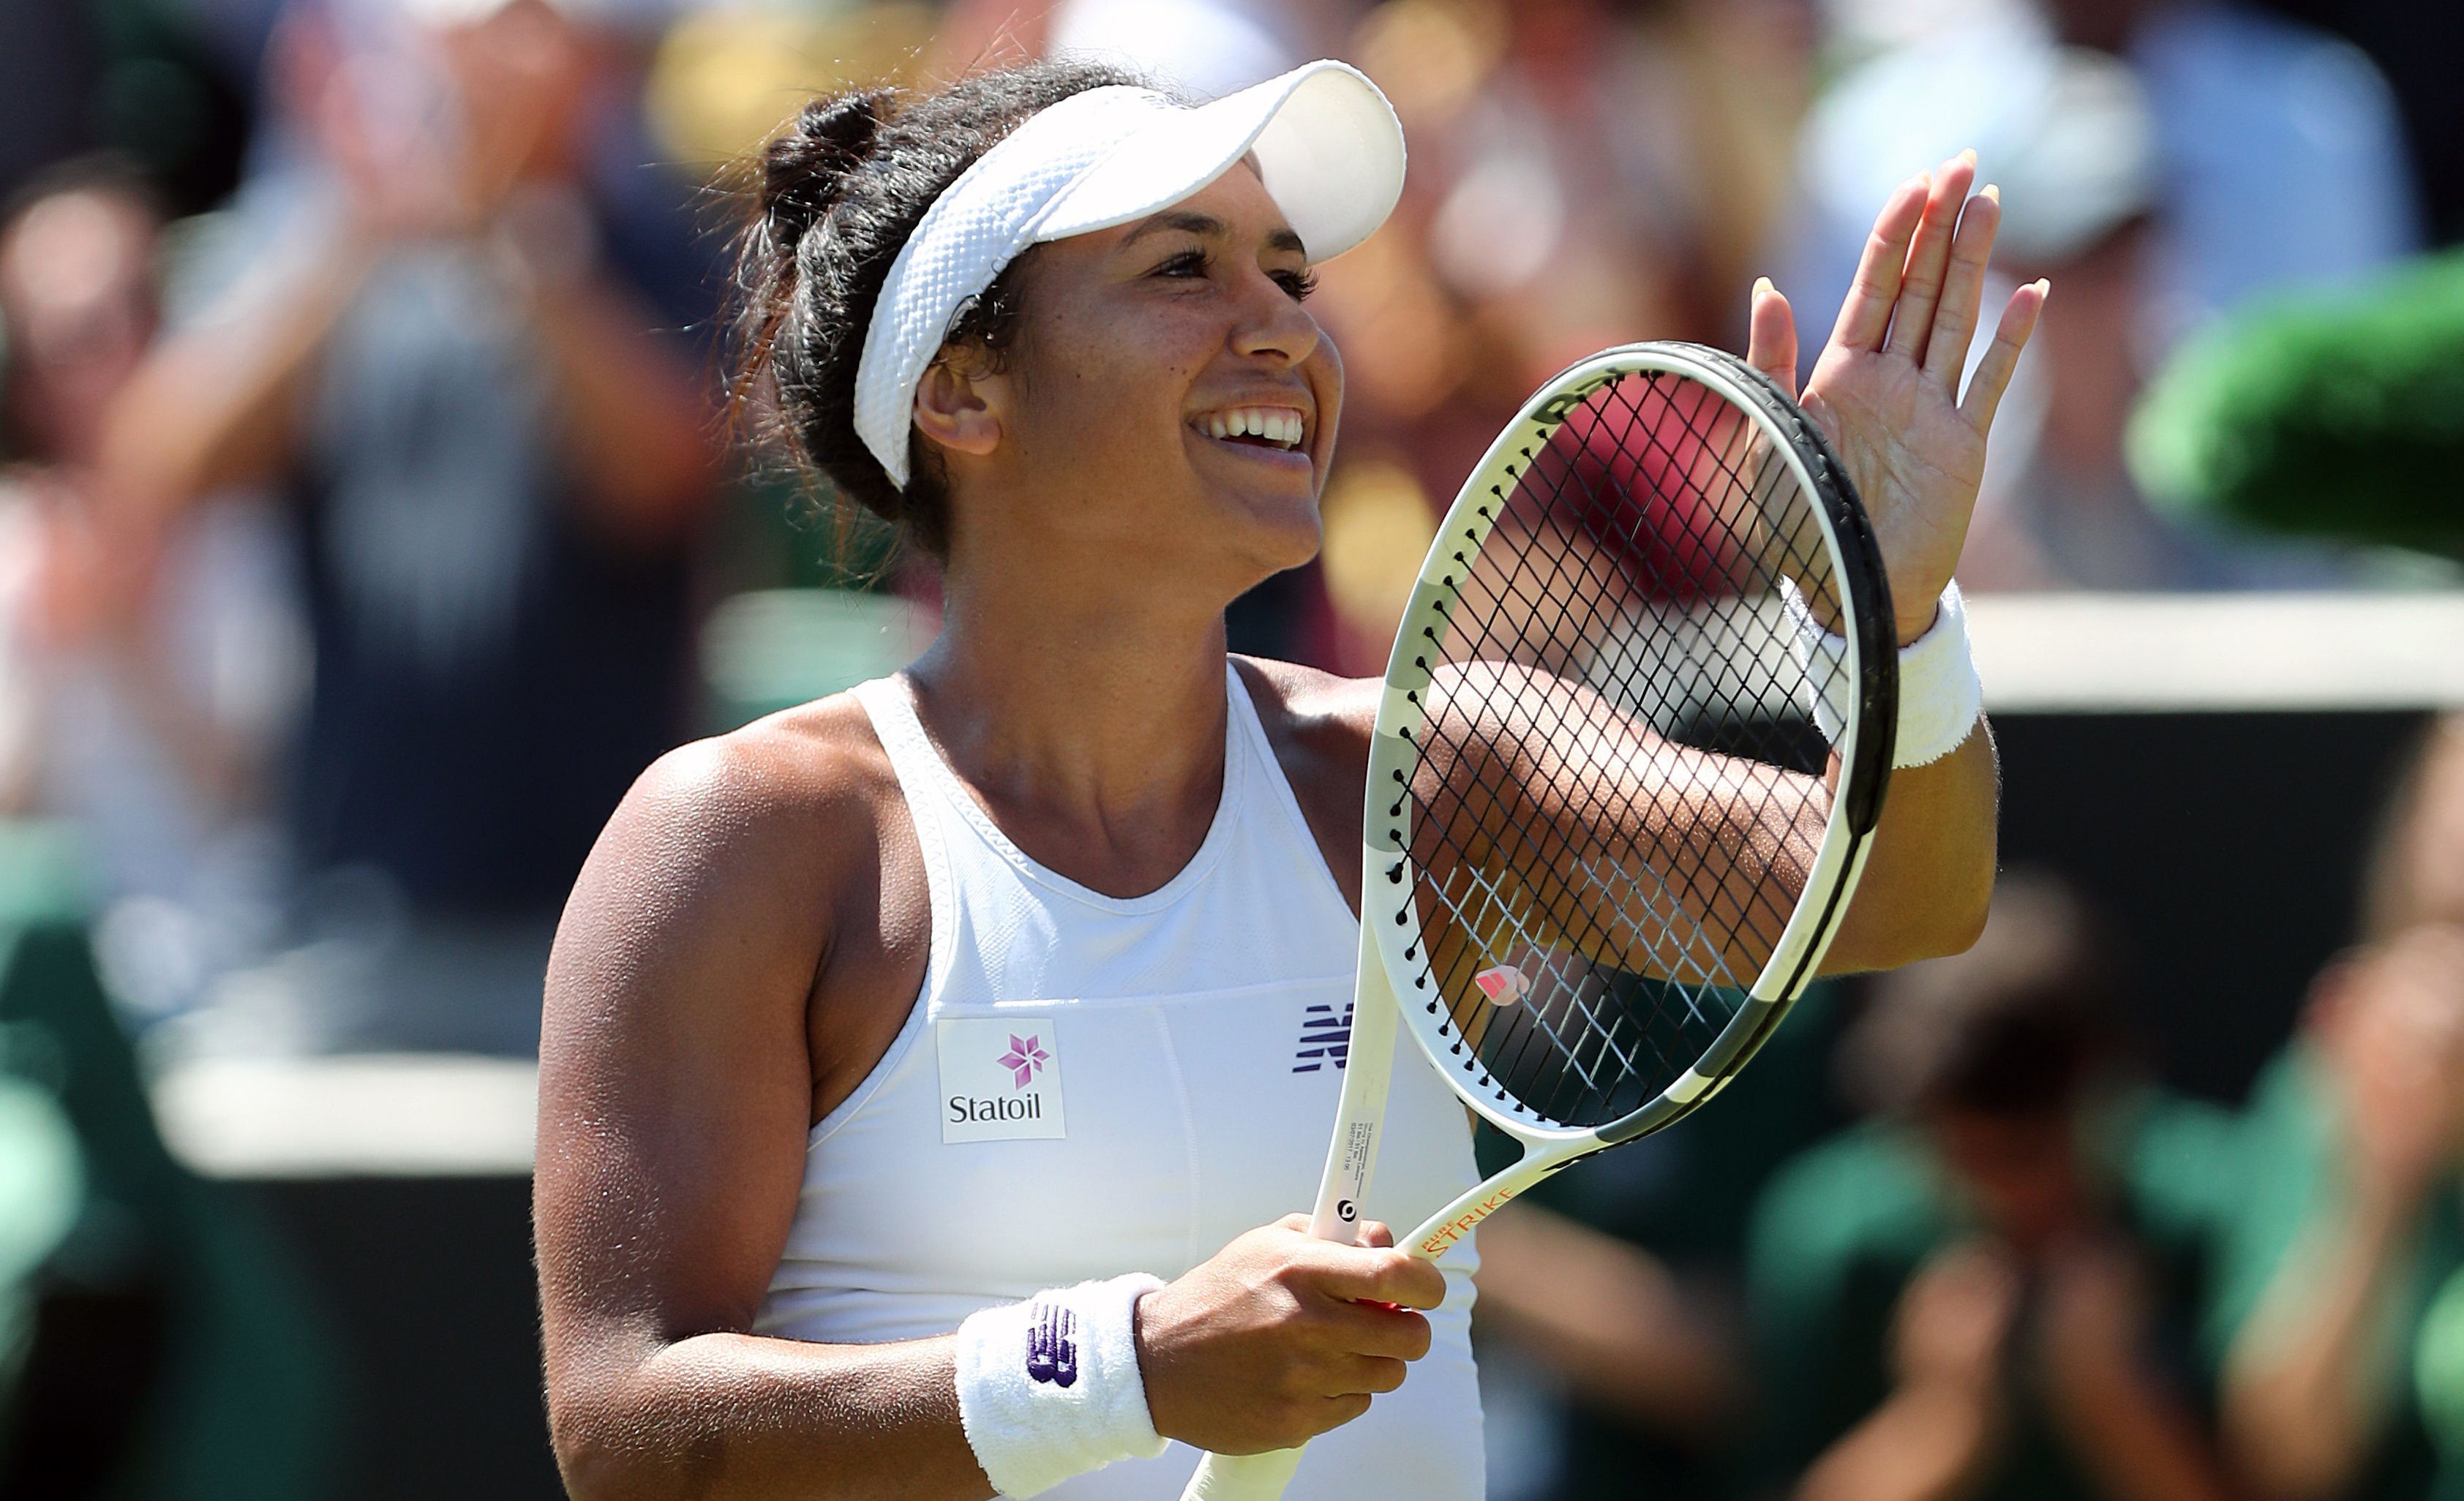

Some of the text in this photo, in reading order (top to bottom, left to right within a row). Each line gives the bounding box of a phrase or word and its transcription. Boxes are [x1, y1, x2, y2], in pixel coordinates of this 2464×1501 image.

[950, 1093, 1040, 1123] Statoil
[1421, 1220, 1454, 1249] PURE
[1427, 1186, 1514, 1258] STRIKE
